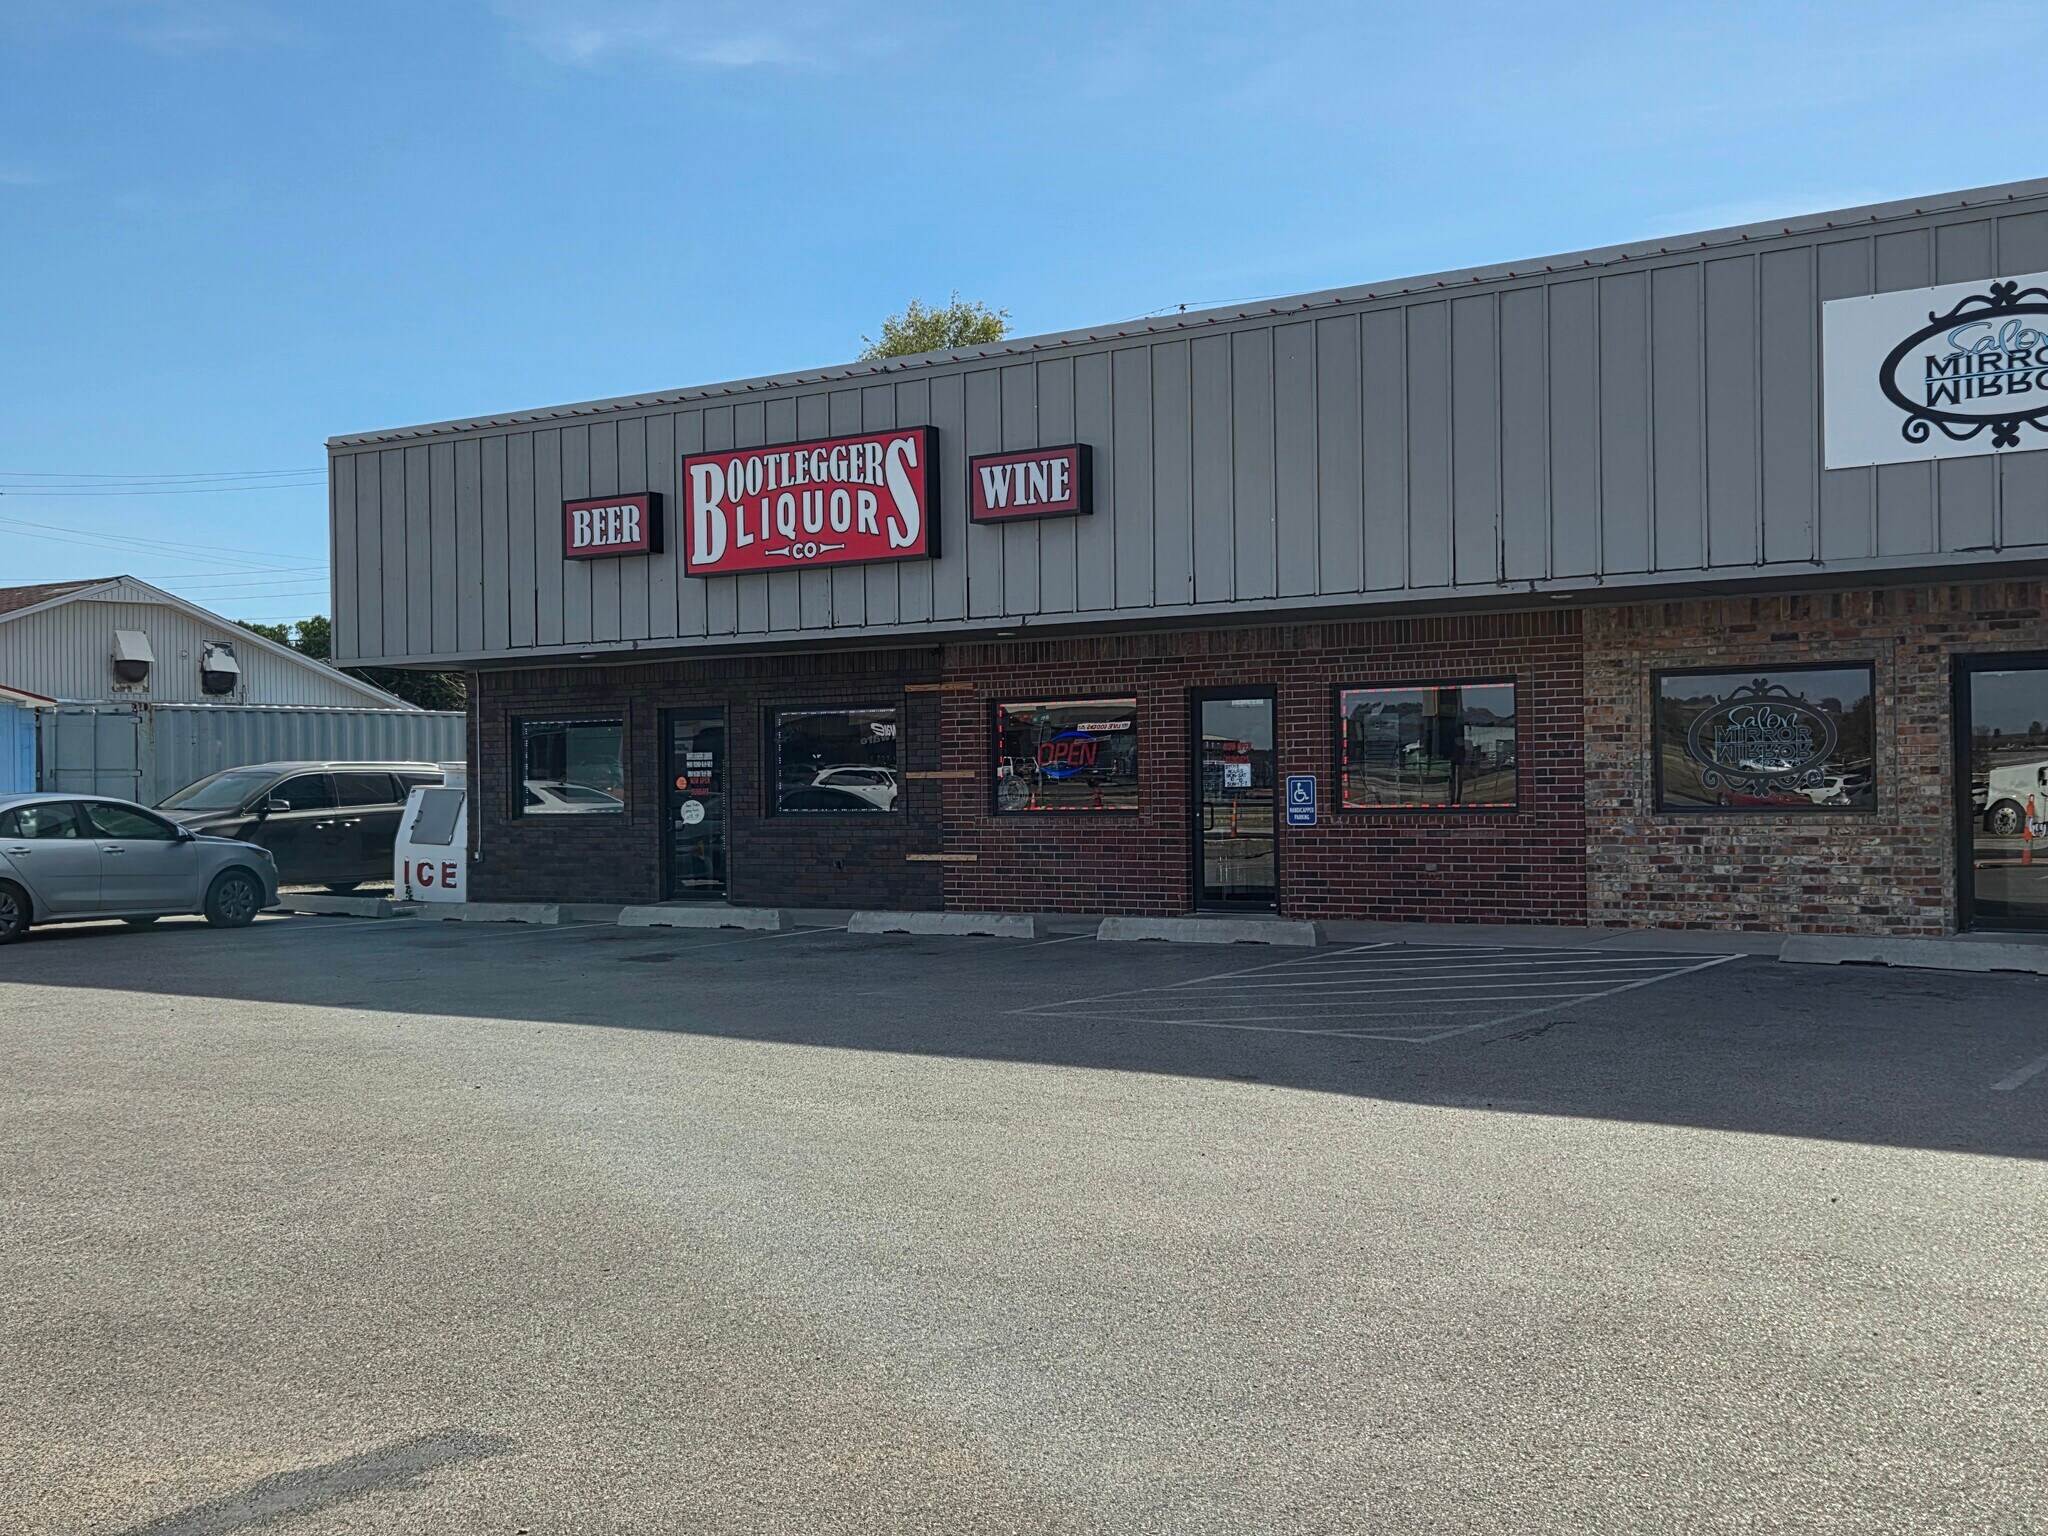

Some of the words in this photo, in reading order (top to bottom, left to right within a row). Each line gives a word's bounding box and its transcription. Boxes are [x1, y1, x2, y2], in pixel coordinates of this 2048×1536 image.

[1943, 318, 2048, 362] Salo
[979, 457, 1071, 510] WINE
[690, 437, 920, 566] BOOTLEGGERS
[572, 504, 641, 549] BEER
[792, 541, 817, 560] CO
[1714, 725, 1813, 744] MIRROR
[1726, 706, 1798, 732] Salon
[1037, 742, 1098, 767] OPEN
[404, 857, 458, 889] ICE
